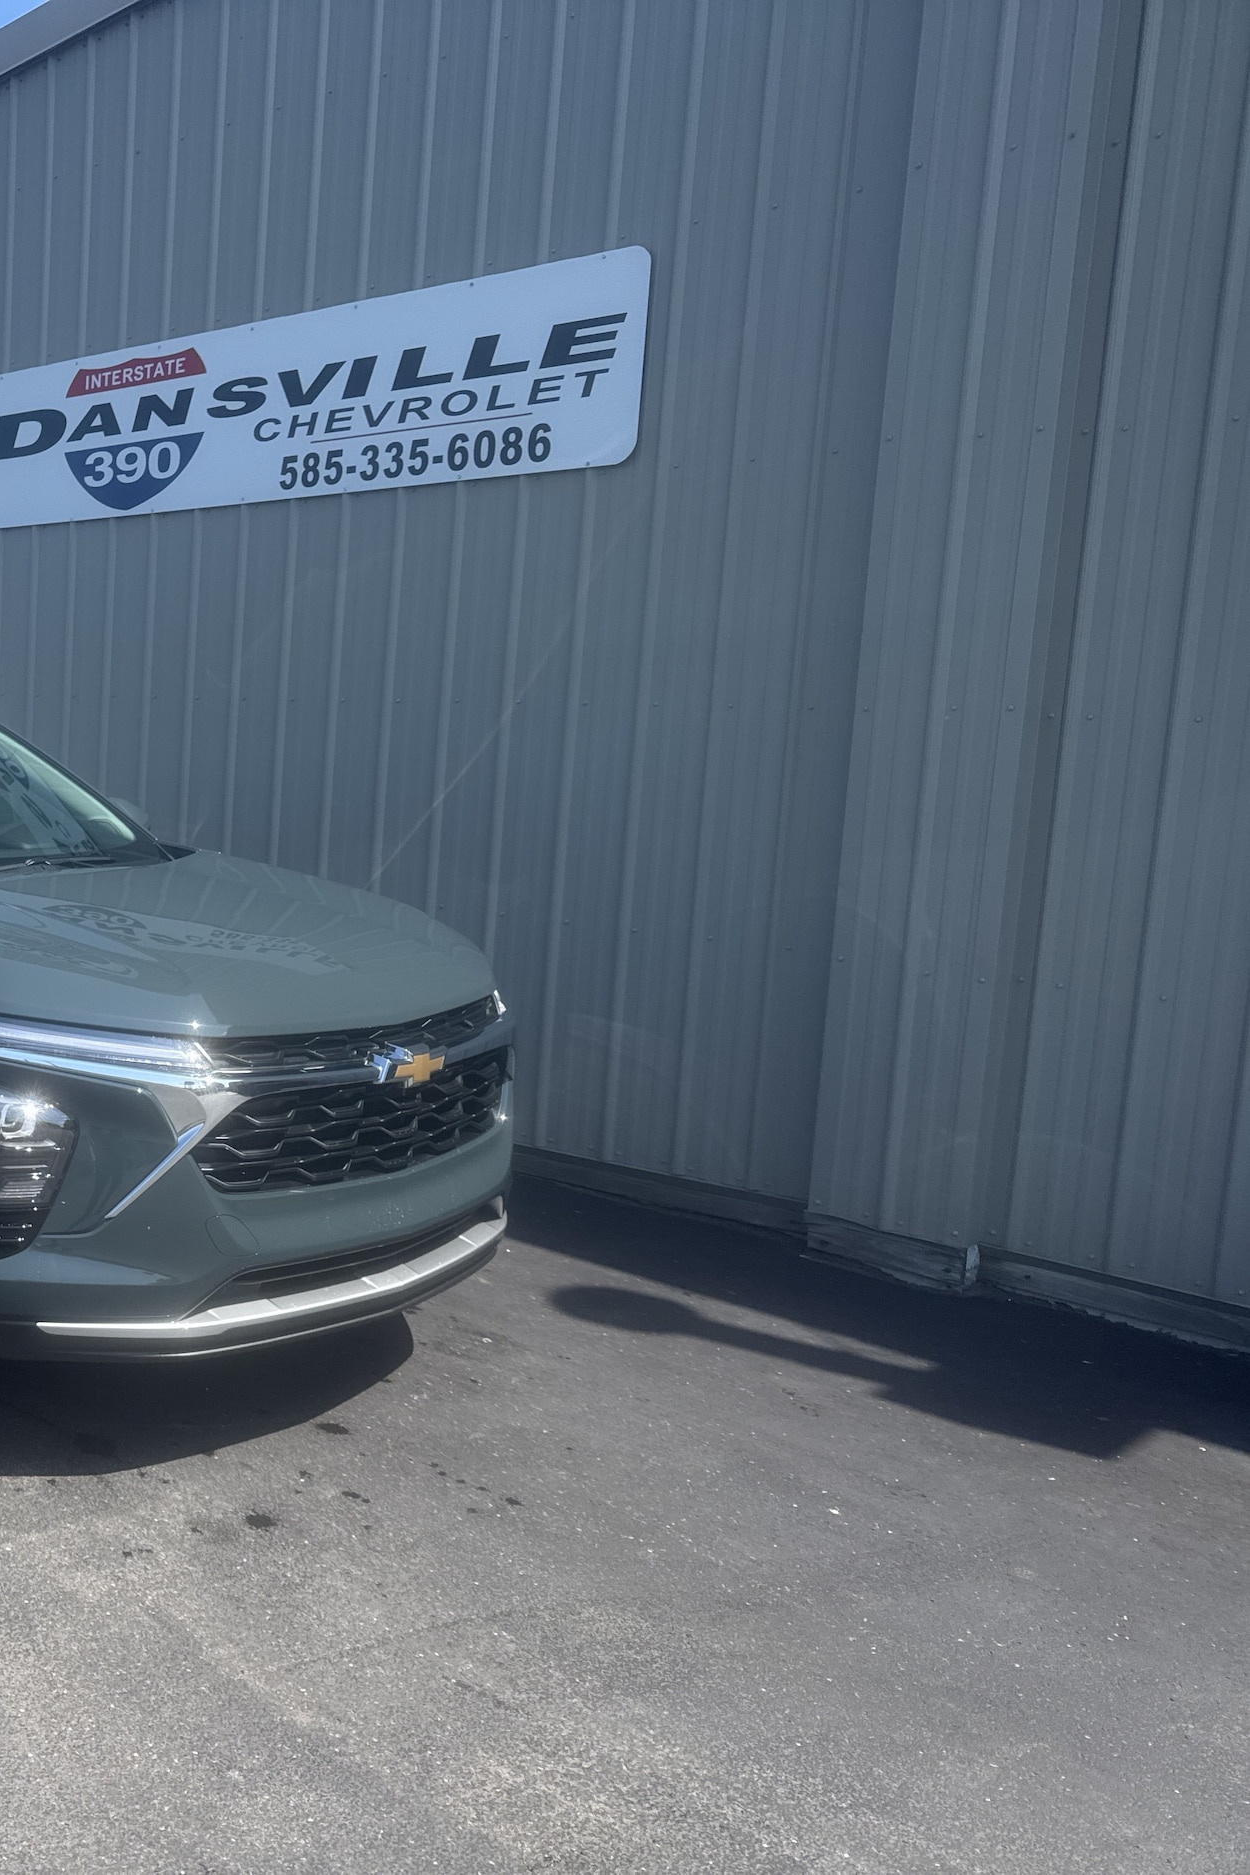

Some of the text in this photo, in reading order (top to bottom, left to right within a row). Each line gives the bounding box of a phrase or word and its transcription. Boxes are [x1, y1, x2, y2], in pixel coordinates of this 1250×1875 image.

[84, 356, 186, 390] INTERSTATE
[253, 368, 610, 442] CHEVROLET
[83, 446, 181, 488] 390
[279, 423, 552, 490] 585-335-6086
